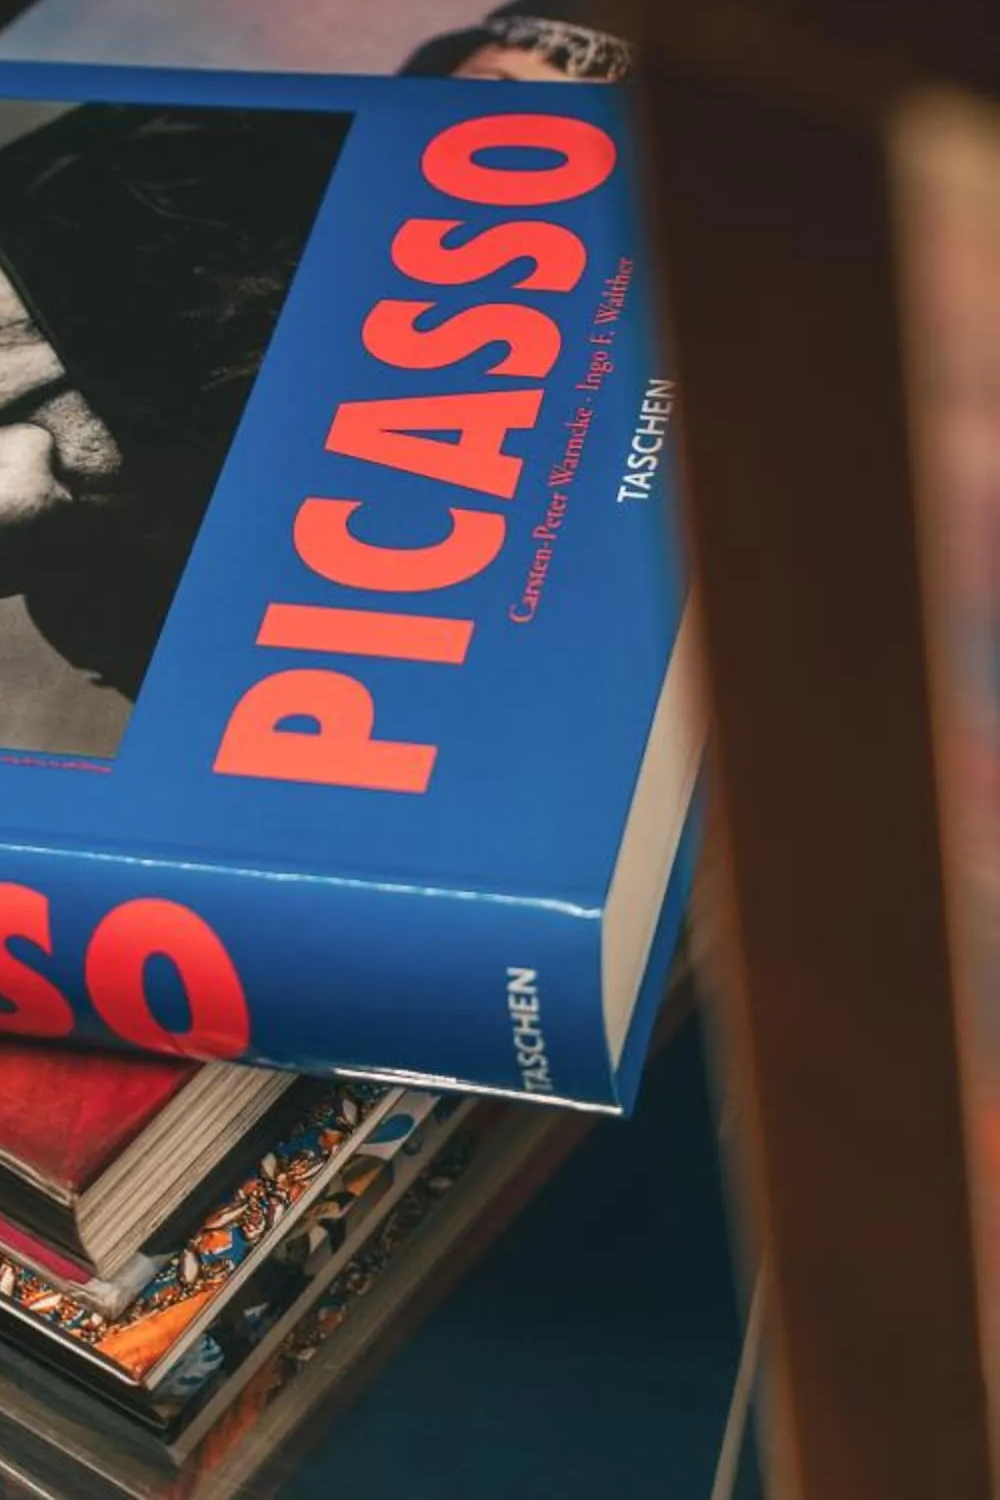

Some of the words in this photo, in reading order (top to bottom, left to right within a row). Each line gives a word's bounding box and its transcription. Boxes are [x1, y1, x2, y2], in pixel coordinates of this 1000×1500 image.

[593, 257, 633, 325] Walther
[575, 350, 614, 391] Ingo
[212, 112, 618, 795] PICASSO
[547, 407, 593, 487] Warncke
[616, 379, 676, 504] TASCHEN
[508, 491, 568, 623] Carsten-Peter
[505, 966, 554, 1091] TASCHEN
